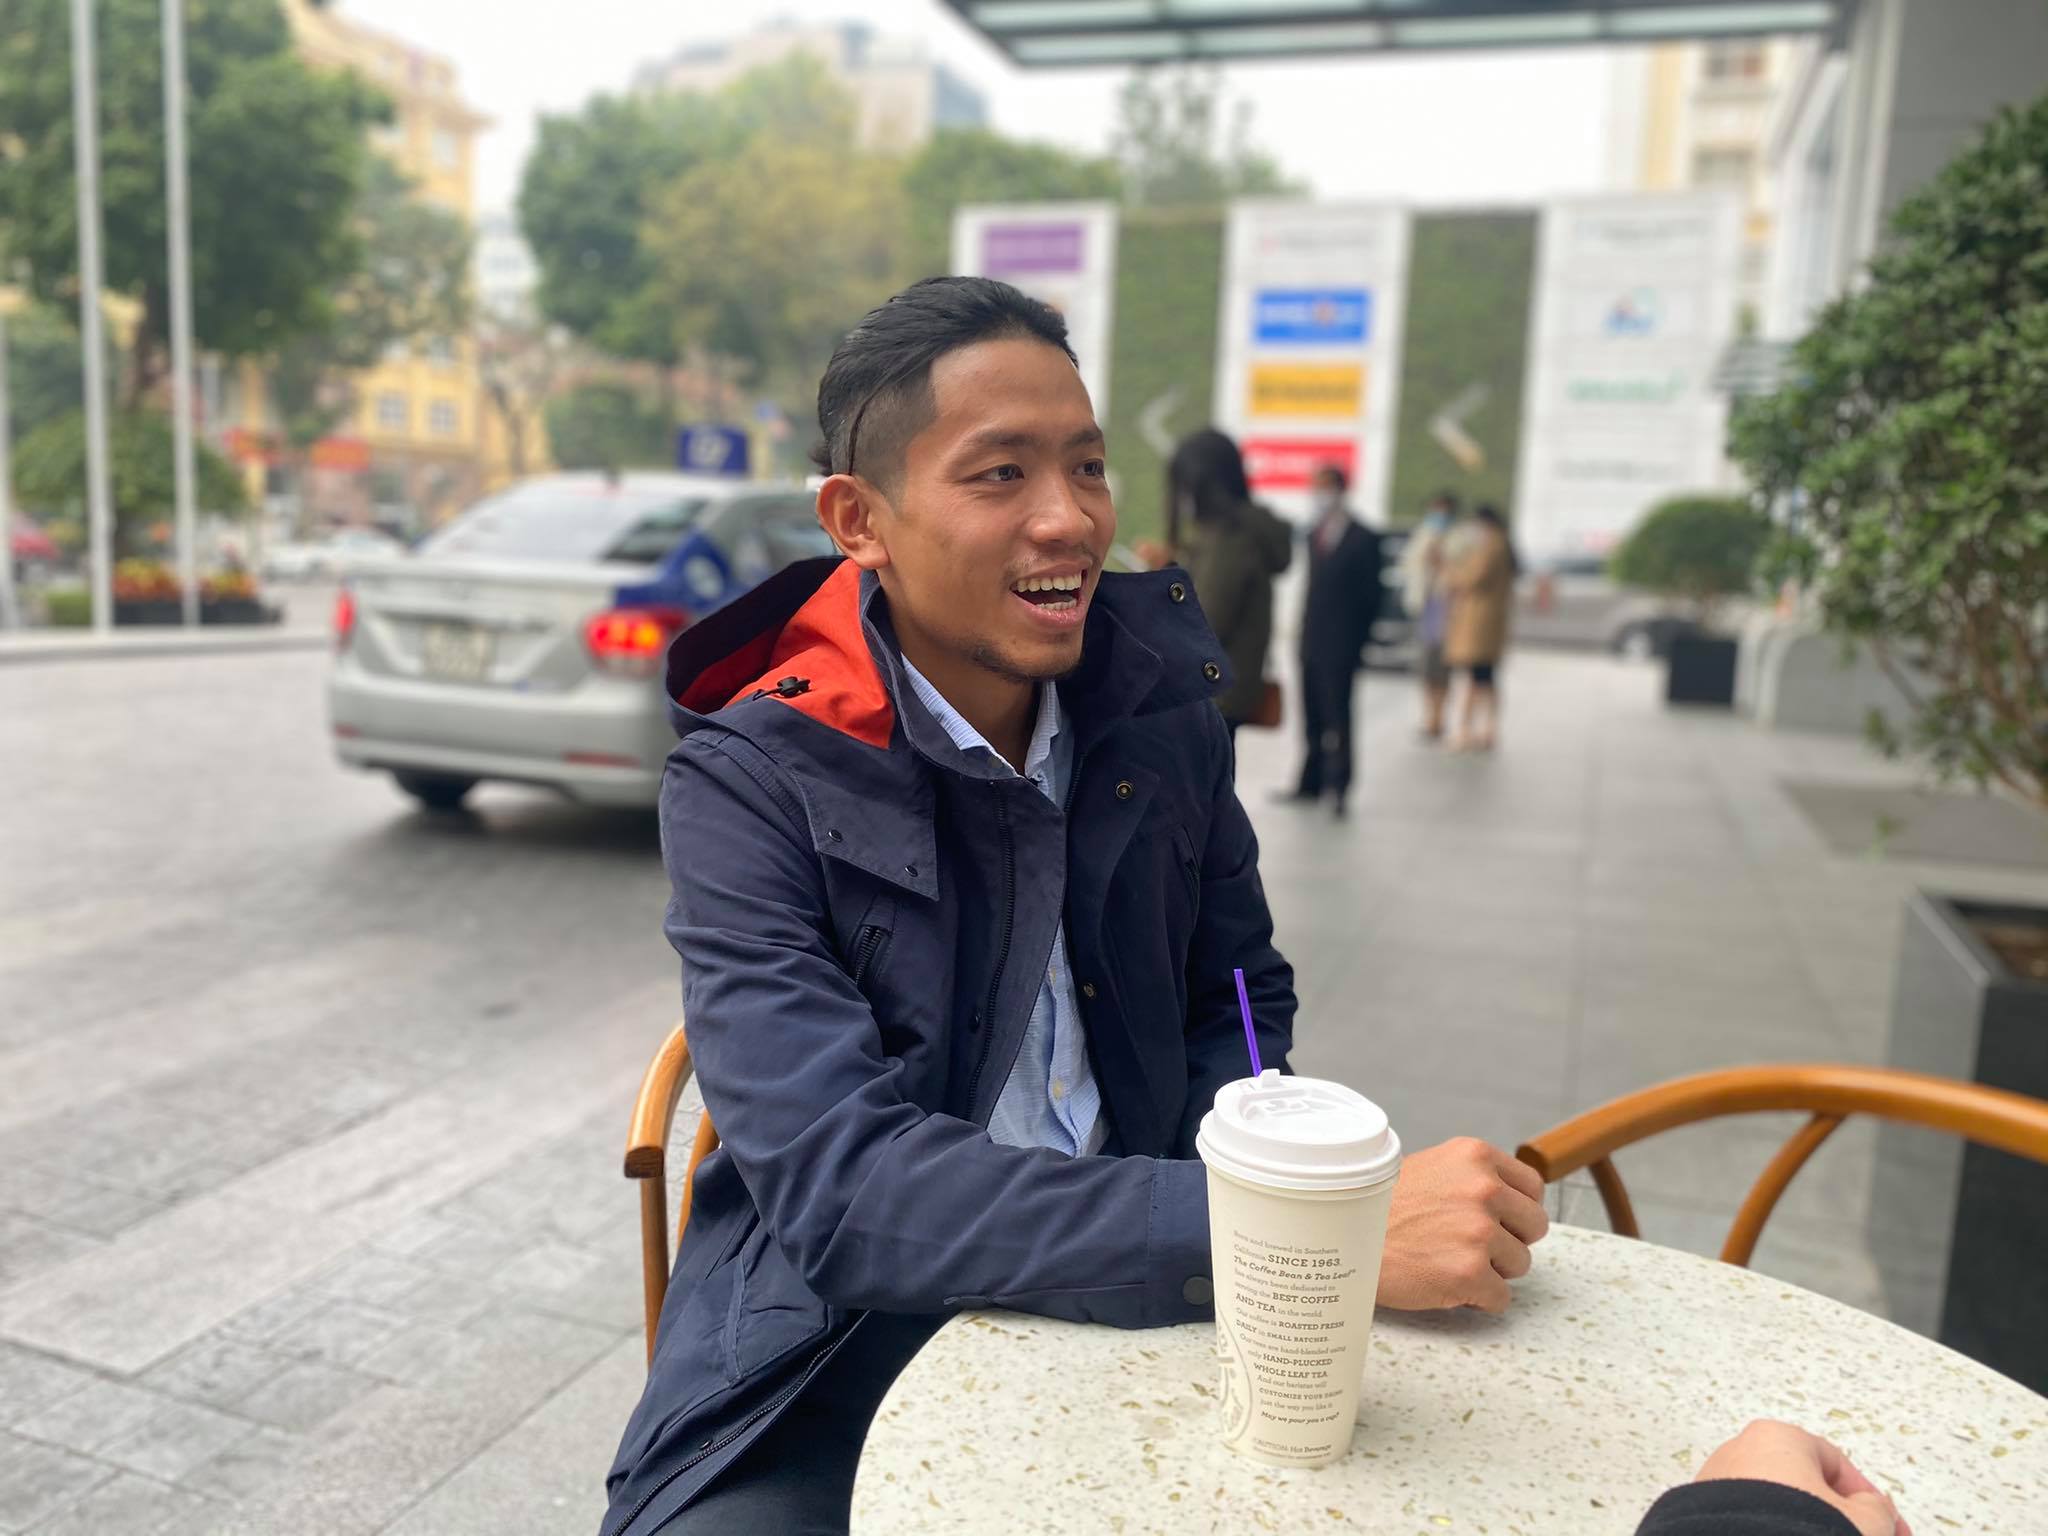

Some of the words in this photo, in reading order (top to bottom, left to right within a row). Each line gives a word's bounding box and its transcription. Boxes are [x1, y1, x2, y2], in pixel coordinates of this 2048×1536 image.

[1250, 1238, 1263, 1247] and
[1265, 1241, 1293, 1252] brewed
[1304, 1247, 1338, 1255] Southern
[1234, 1255, 1247, 1267] The
[1249, 1262, 1276, 1276] Coffee
[1278, 1270, 1302, 1280] Bean
[1268, 1254, 1308, 1267] SINCE
[1246, 1273, 1268, 1285] always
[1270, 1280, 1288, 1289] been
[1290, 1283, 1327, 1291] dedicated
[1236, 1293, 1254, 1306] AND
[1256, 1301, 1276, 1313] TEA
[1287, 1308, 1299, 1316] the
[1259, 1290, 1270, 1298] the
[1272, 1292, 1298, 1303] BEST
[1300, 1295, 1340, 1304] COFFEE
[1236, 1307, 1248, 1317] Our
[1249, 1314, 1269, 1324] coffee
[1278, 1321, 1319, 1330] ROASTED
[1320, 1320, 1345, 1329] FRESH
[1236, 1319, 1257, 1333] DAILY
[1267, 1332, 1292, 1342] SMALL
[1240, 1333, 1252, 1344] Our
[1253, 1362, 1286, 1377] WHOLE
[1287, 1370, 1310, 1378] LEAF
[1257, 1374, 1271, 1384] And
[1286, 1380, 1313, 1389] baristas
[1258, 1387, 1302, 1400] CUSTOMIZE
[1274, 1401, 1285, 1409] the
[1315, 1402, 1326, 1410] like
[1261, 1411, 1277, 1422] May
